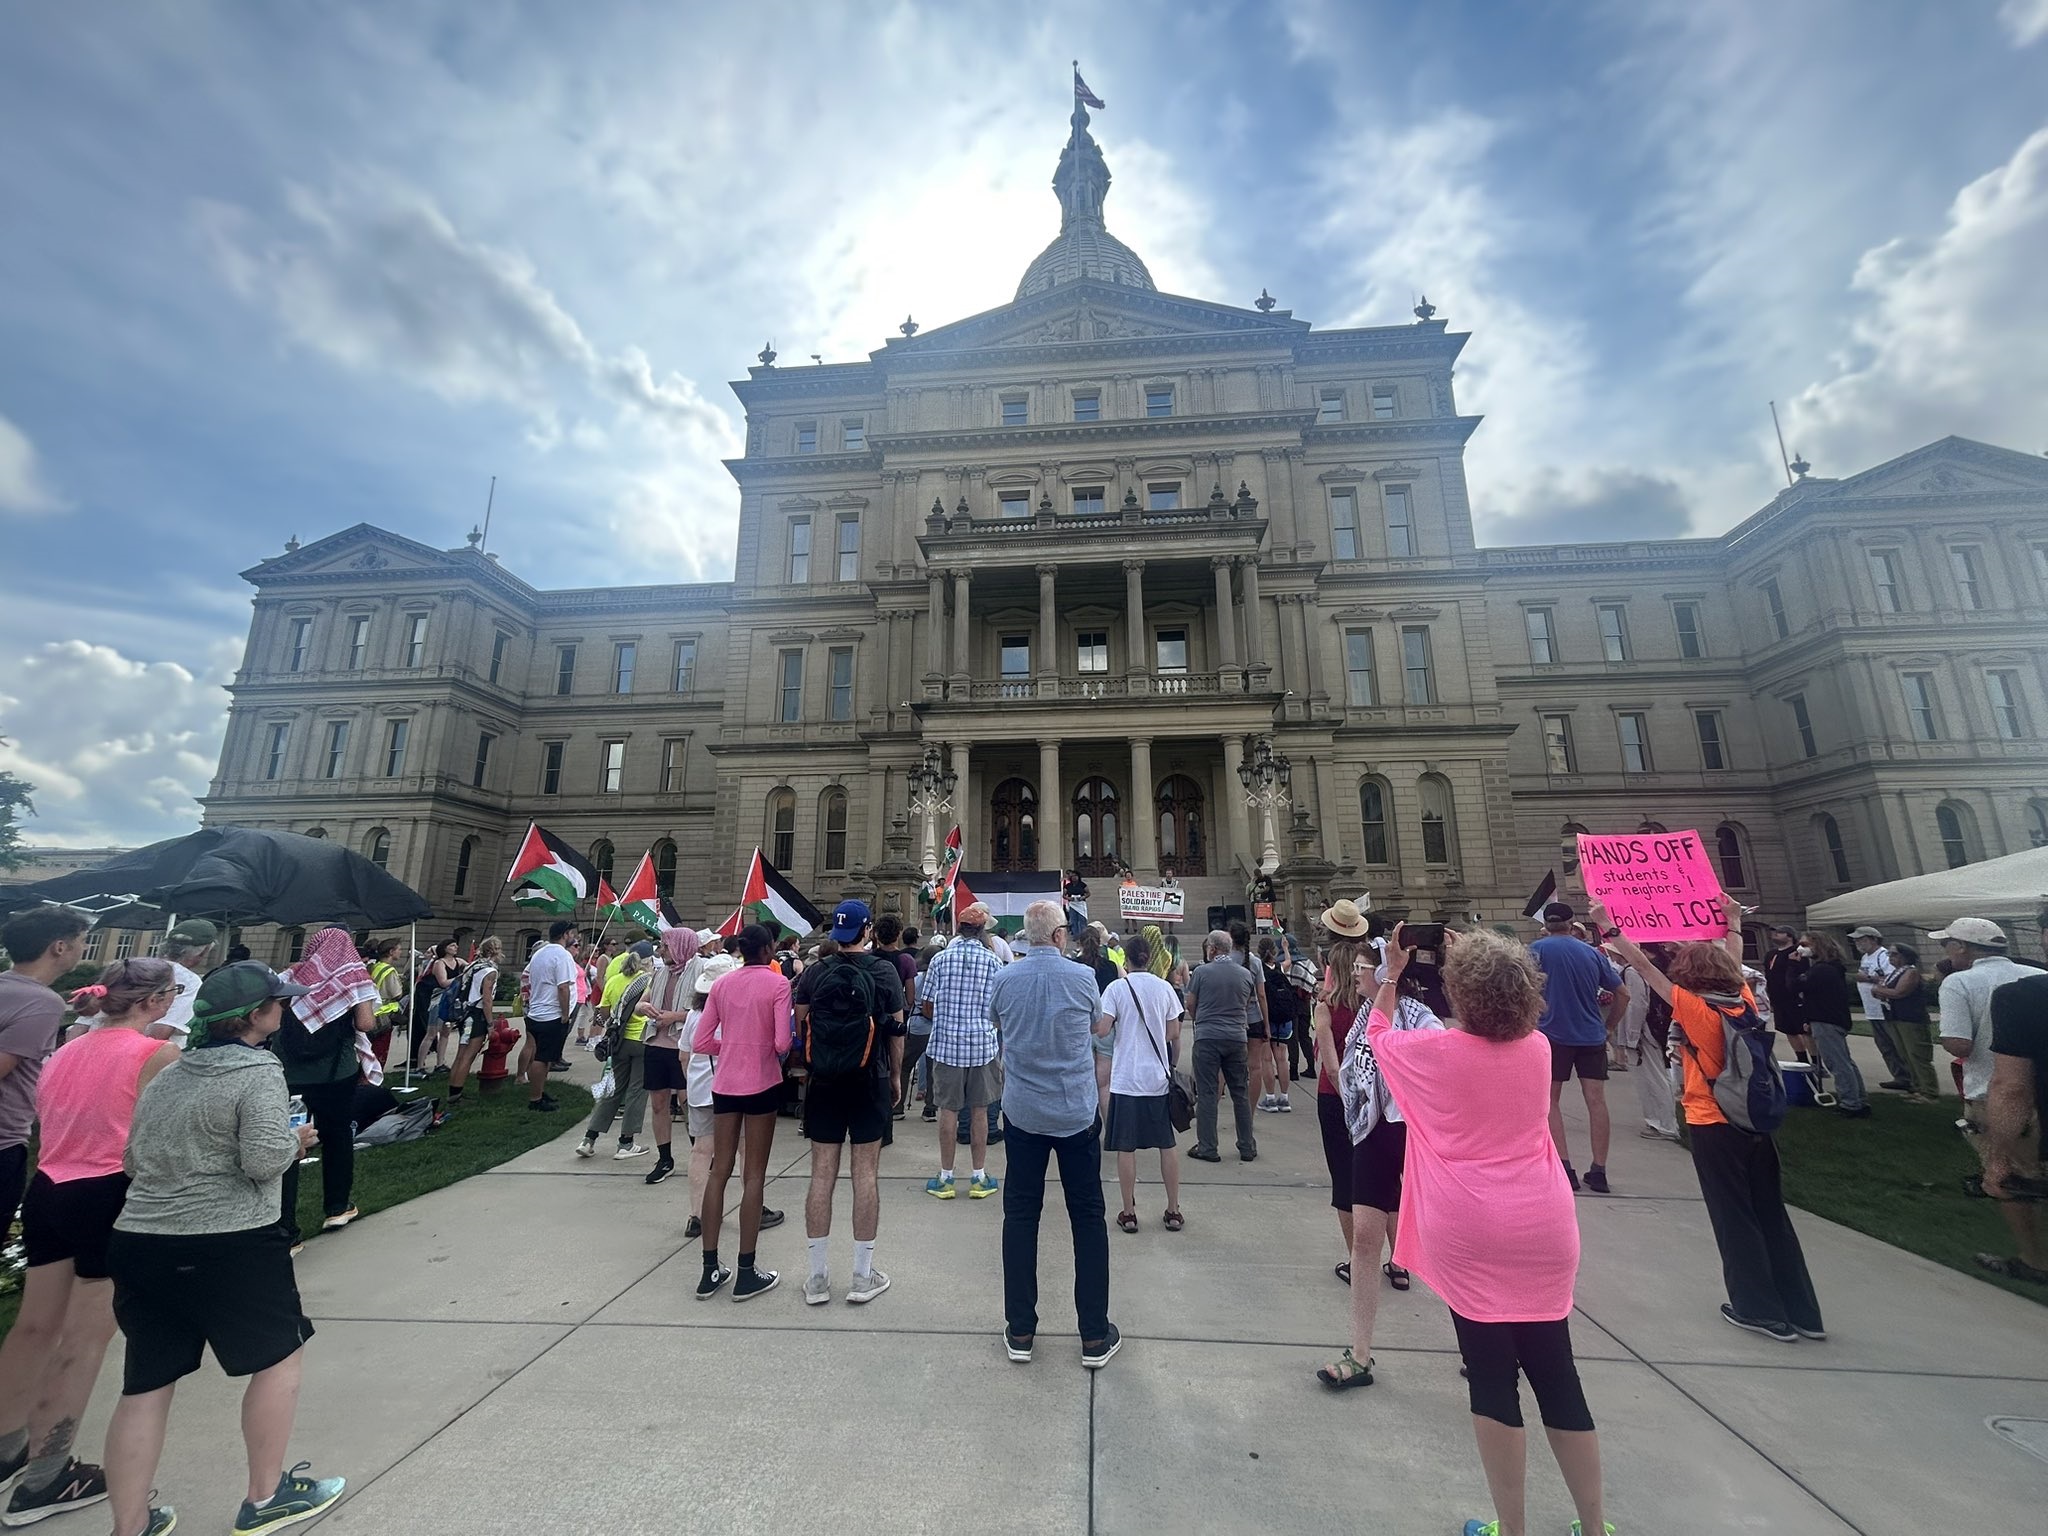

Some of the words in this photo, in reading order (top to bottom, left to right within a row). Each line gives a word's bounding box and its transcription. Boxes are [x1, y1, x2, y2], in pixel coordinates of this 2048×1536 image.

[1579, 841, 1649, 865] HANDS
[1654, 837, 1693, 862] OFF
[1603, 868, 1669, 883] students
[1121, 890, 1161, 899] PALESTINE
[1595, 886, 1614, 896] our
[1622, 882, 1682, 901] neighors
[1121, 898, 1162, 906] SOLIDARITY
[837, 913, 846, 925] T
[1673, 898, 1728, 928] ICE
